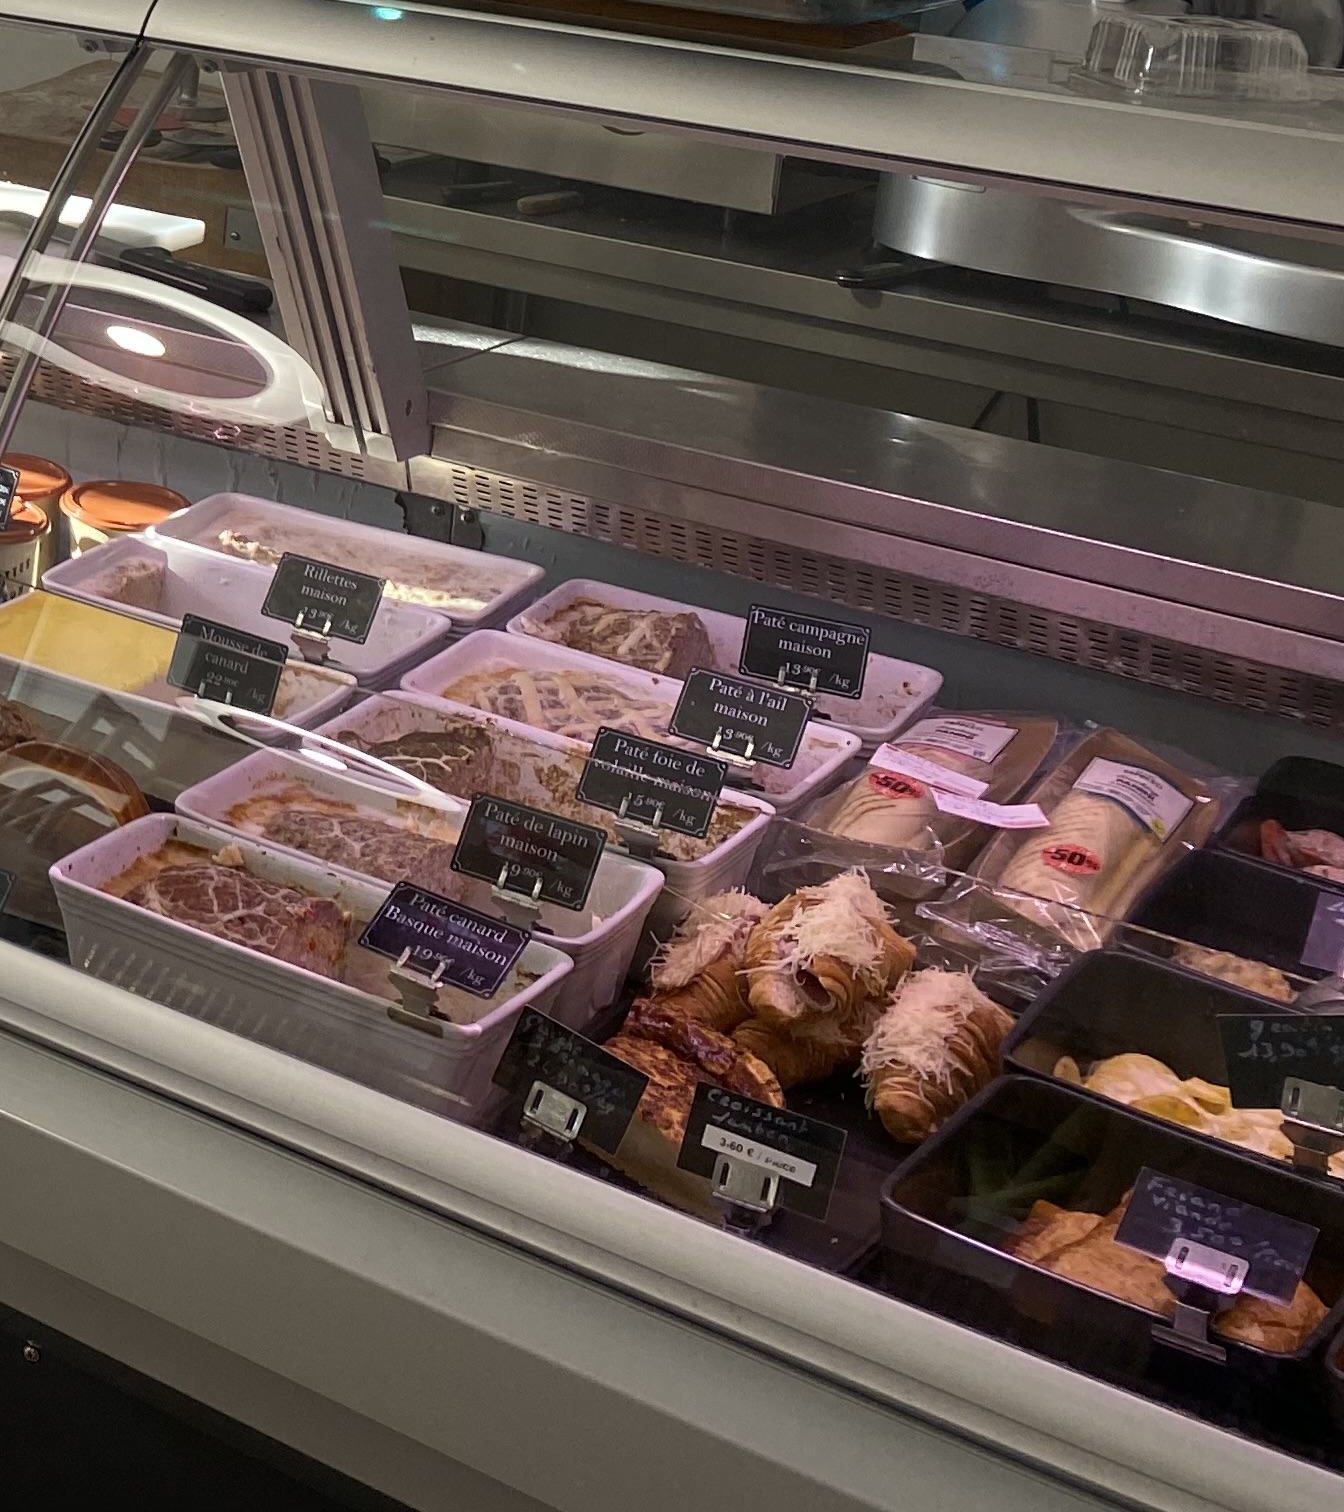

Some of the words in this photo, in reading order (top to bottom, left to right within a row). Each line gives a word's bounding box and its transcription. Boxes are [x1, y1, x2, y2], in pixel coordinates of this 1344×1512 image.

[304, 564, 358, 590] Rillettes
[301, 584, 347, 606] maison
[752, 609, 786, 630] Paté
[789, 620, 866, 646] campagne
[201, 625, 249, 653] Mousse
[252, 643, 269, 658] de
[778, 638, 832, 659] maison
[205, 651, 250, 675] canard
[829, 673, 851, 689] /kg
[709, 677, 743, 699] Paté
[745, 688, 755, 703] à
[758, 691, 788, 711] l'ail
[713, 702, 768, 727] maison
[614, 738, 649, 761] Paté
[652, 749, 682, 770] foie
[685, 760, 706, 778] de
[761, 741, 784, 759] /kg
[593, 758, 648, 783] volaille
[652, 776, 712, 803] maison
[484, 801, 520, 826] Paté
[523, 815, 545, 834] de
[548, 822, 590, 849] lapin
[672, 808, 697, 827] /kg
[499, 833, 560, 863] maison
[550, 879, 575, 899] /kg
[409, 892, 448, 919] Paté
[449, 913, 509, 944] canard
[384, 903, 445, 940] Basque
[446, 934, 508, 967] maison
[460, 968, 487, 987] /kg
[747, 1147, 755, 1159] €
